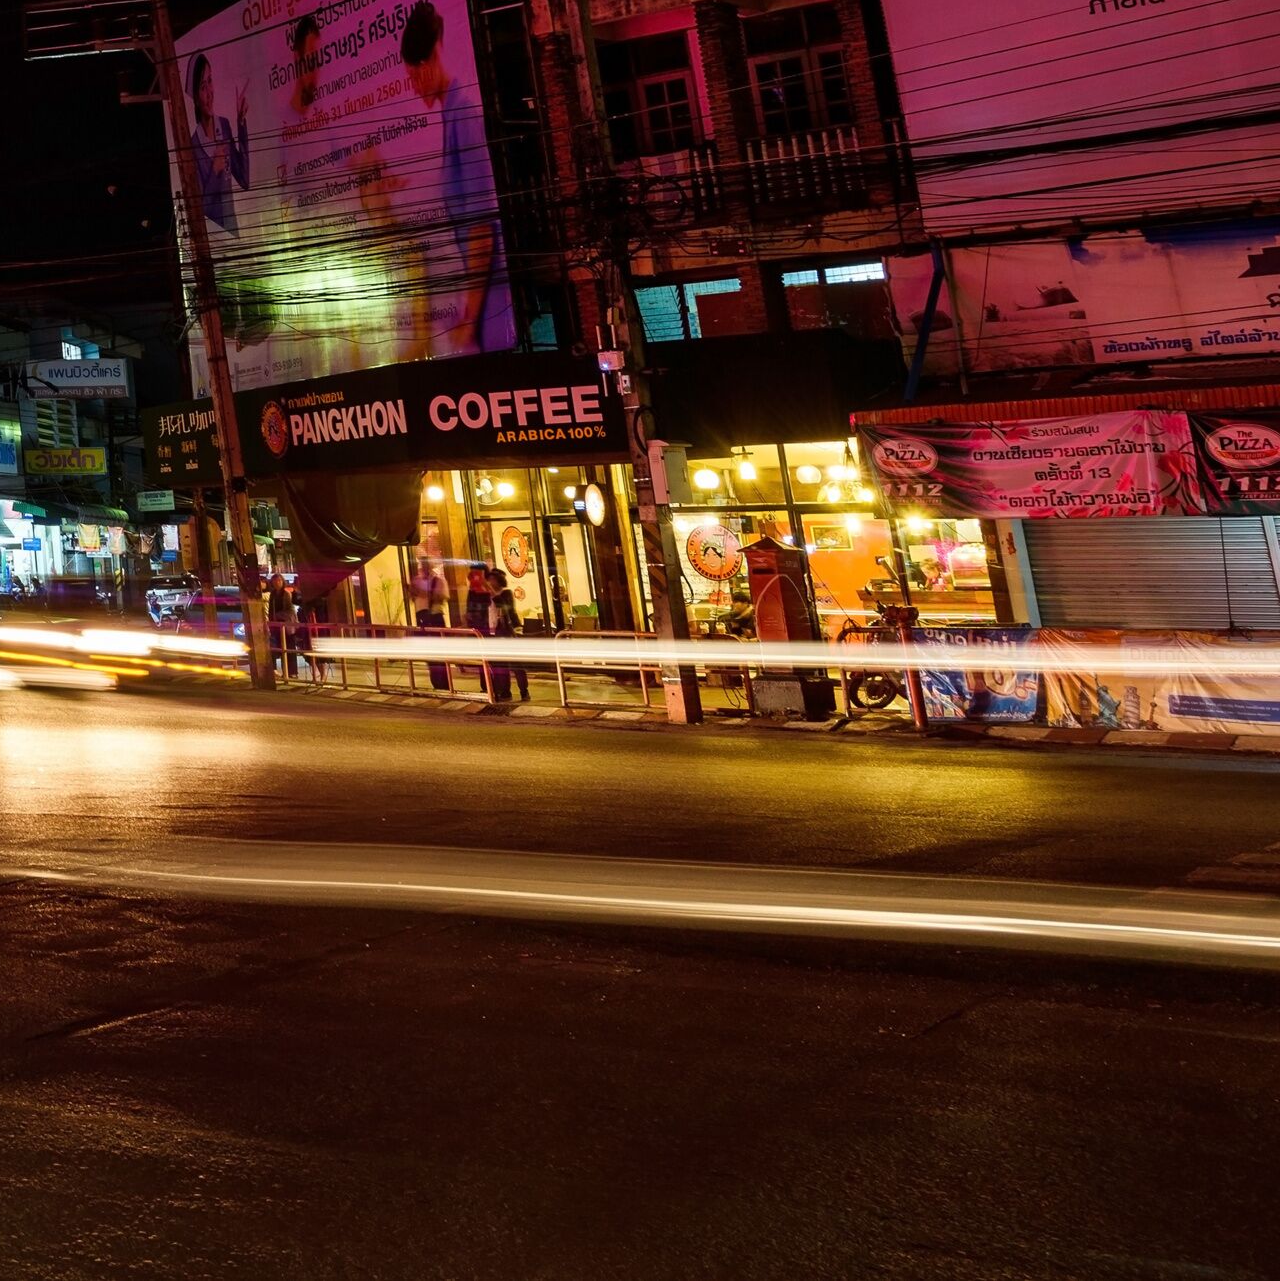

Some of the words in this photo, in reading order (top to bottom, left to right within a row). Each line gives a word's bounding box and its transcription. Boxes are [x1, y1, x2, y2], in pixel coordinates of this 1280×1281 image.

[376, 80, 402, 103] 2560
[1102, 336, 1193, 354] ห้องพักหรู
[48, 362, 122, 379] แพนบิวตี้แคร์
[428, 384, 604, 433] COFFEE
[290, 399, 408, 447] PANGKHON
[496, 429, 567, 444] ARABICA
[567, 425, 607, 440] 100%
[1237, 430, 1253, 438] The
[1219, 436, 1274, 451] PIZZA
[884, 447, 928, 461] PIZZA
[1087, 466, 1112, 480] 13
[882, 482, 944, 497] 1112
